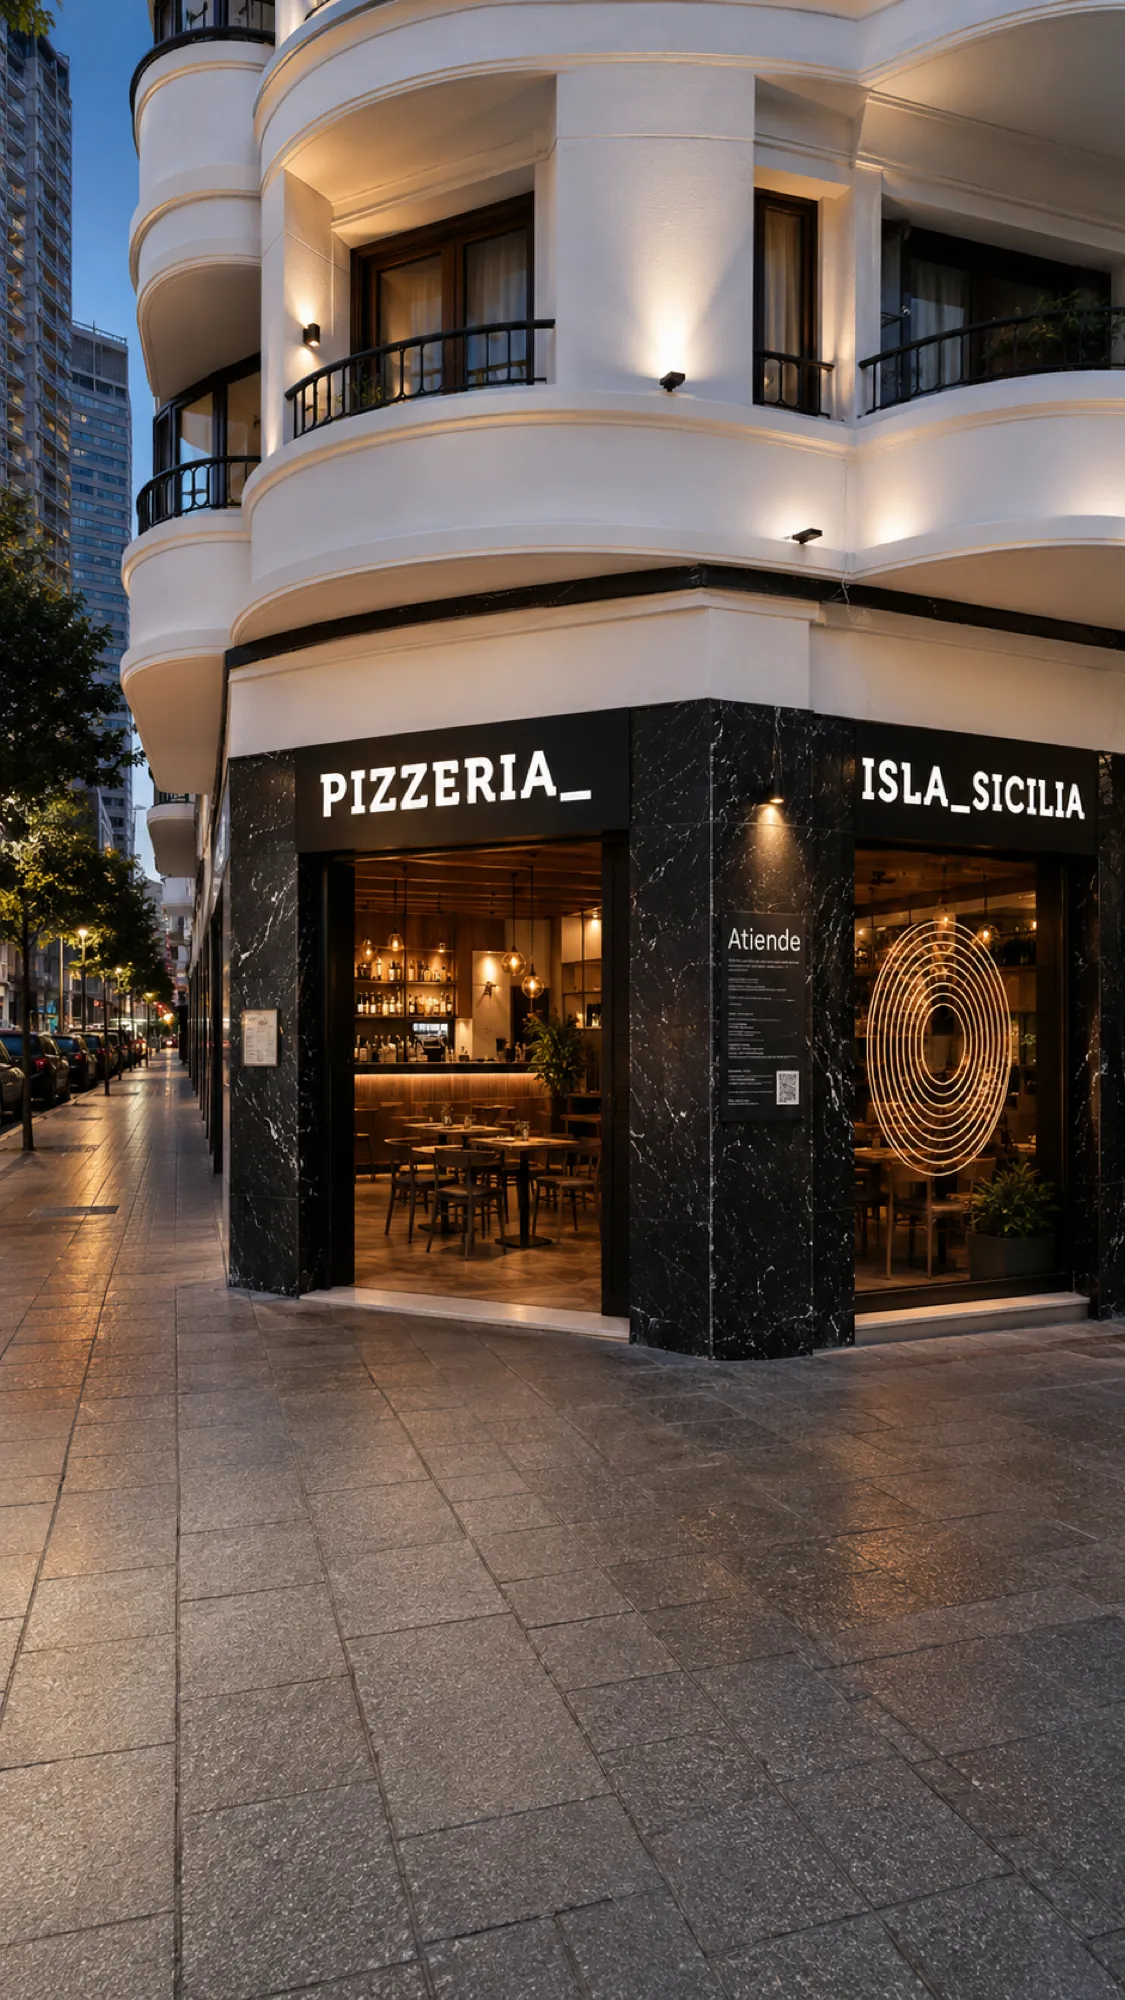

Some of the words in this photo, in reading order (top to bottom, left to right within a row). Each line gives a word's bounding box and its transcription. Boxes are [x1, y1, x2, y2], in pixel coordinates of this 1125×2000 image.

[320, 751, 592, 818] PIZZERIA_
[861, 757, 1086, 820] ISLA_SICILIA
[728, 927, 801, 952] Atiende
